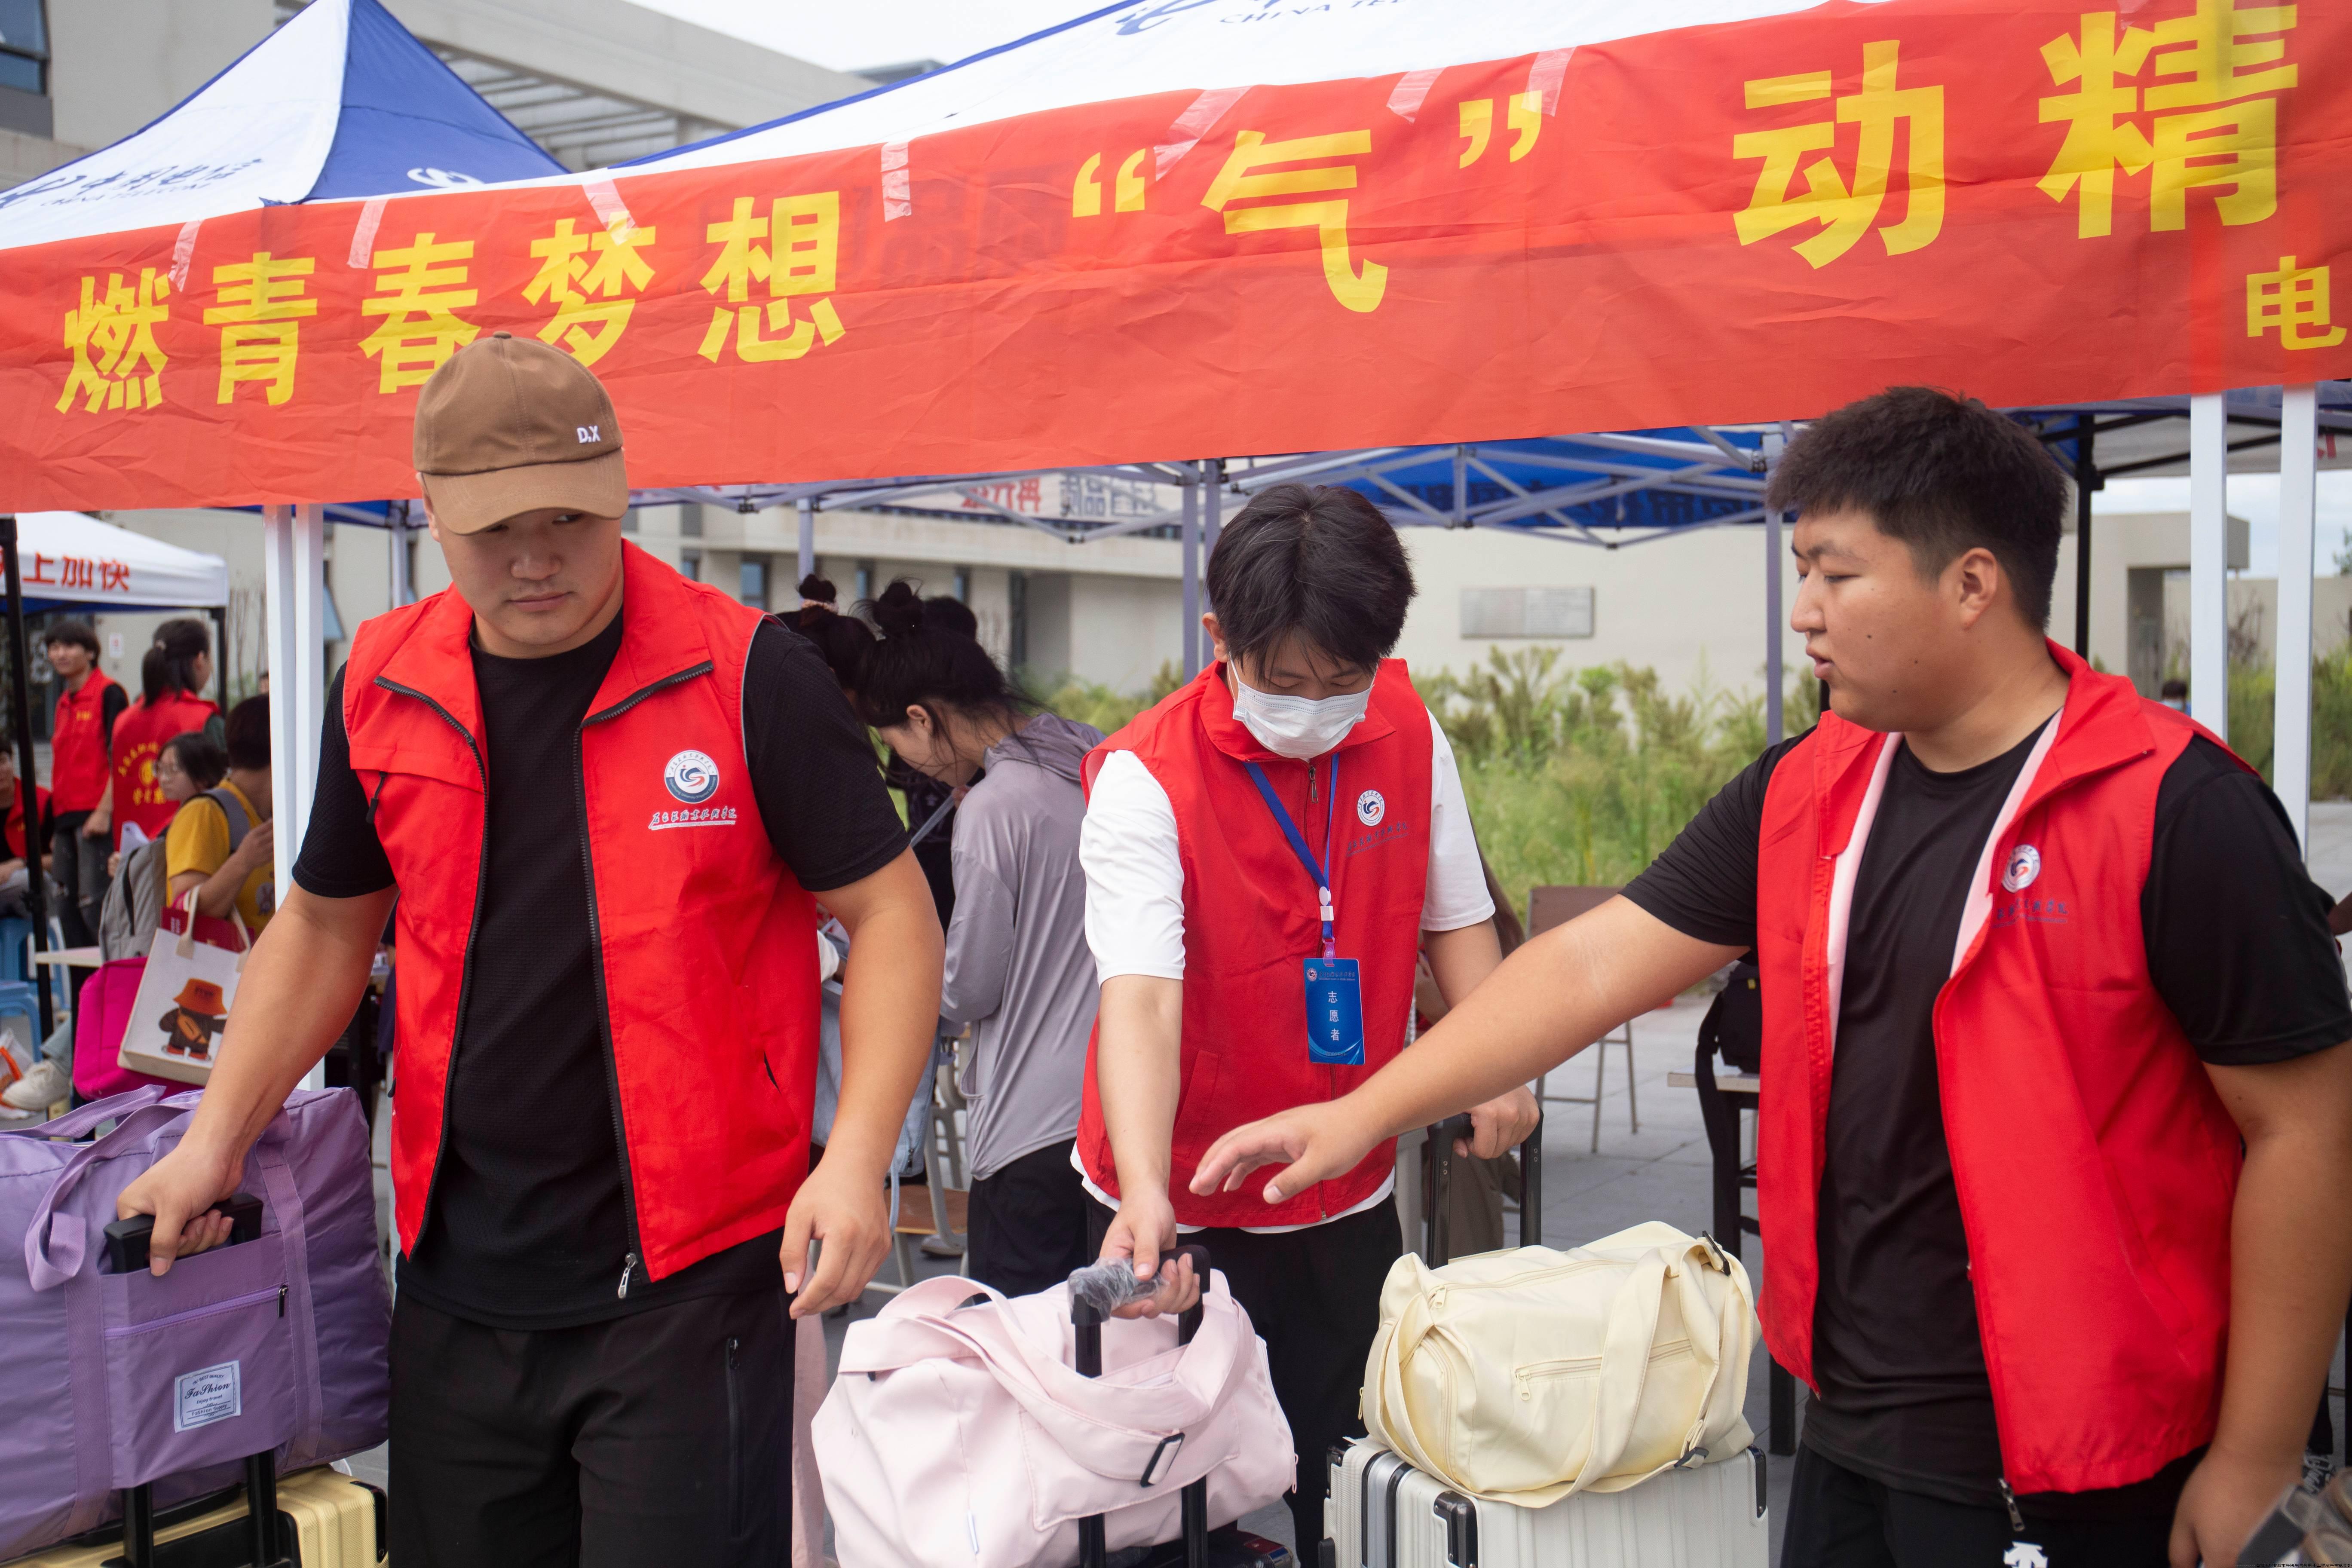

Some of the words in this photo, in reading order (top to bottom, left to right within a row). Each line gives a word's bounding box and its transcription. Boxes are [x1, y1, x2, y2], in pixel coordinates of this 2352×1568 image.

[1220, 4, 1331, 23] CHINA
[2246, 255, 2347, 350] 电
[0, 545, 130, 590] 上加快
[1328, 991, 1340, 1041] 志愿者
